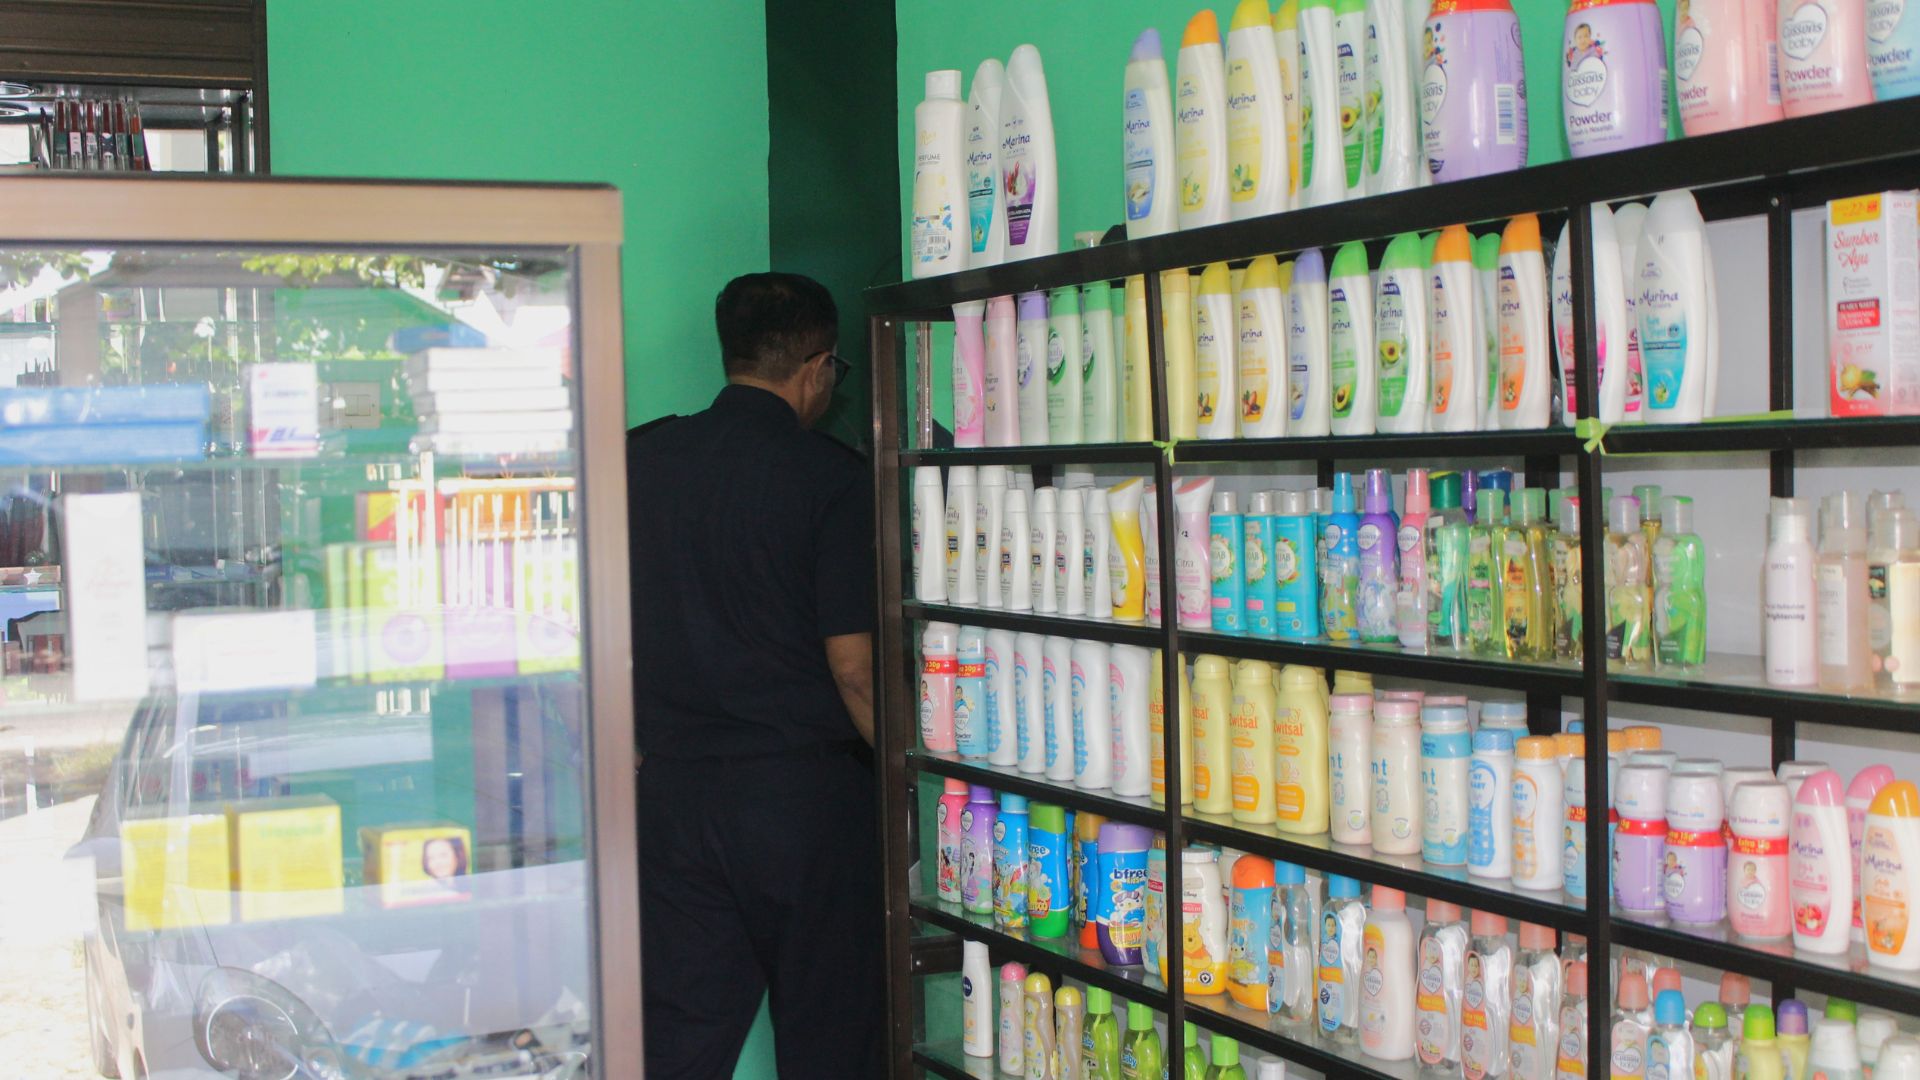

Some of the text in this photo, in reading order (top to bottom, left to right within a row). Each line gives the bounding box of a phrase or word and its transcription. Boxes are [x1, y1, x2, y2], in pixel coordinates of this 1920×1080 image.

[1339, 70, 1358, 84] rina
[1568, 70, 1605, 89] Cussons
[1784, 65, 1833, 82] Powder
[1574, 84, 1599, 99] baby
[1227, 93, 1257, 110] Marina
[1178, 107, 1205, 123] Marina
[1569, 110, 1613, 129] Powder
[1125, 119, 1150, 134] Marina
[1002, 133, 1031, 149] Marina
[1834, 228, 1880, 249] Sumber
[1838, 248, 1869, 272] Ayu
[1639, 288, 1679, 307] Marina
[1791, 840, 1824, 856] Marina
[1865, 854, 1903, 873] Marina
